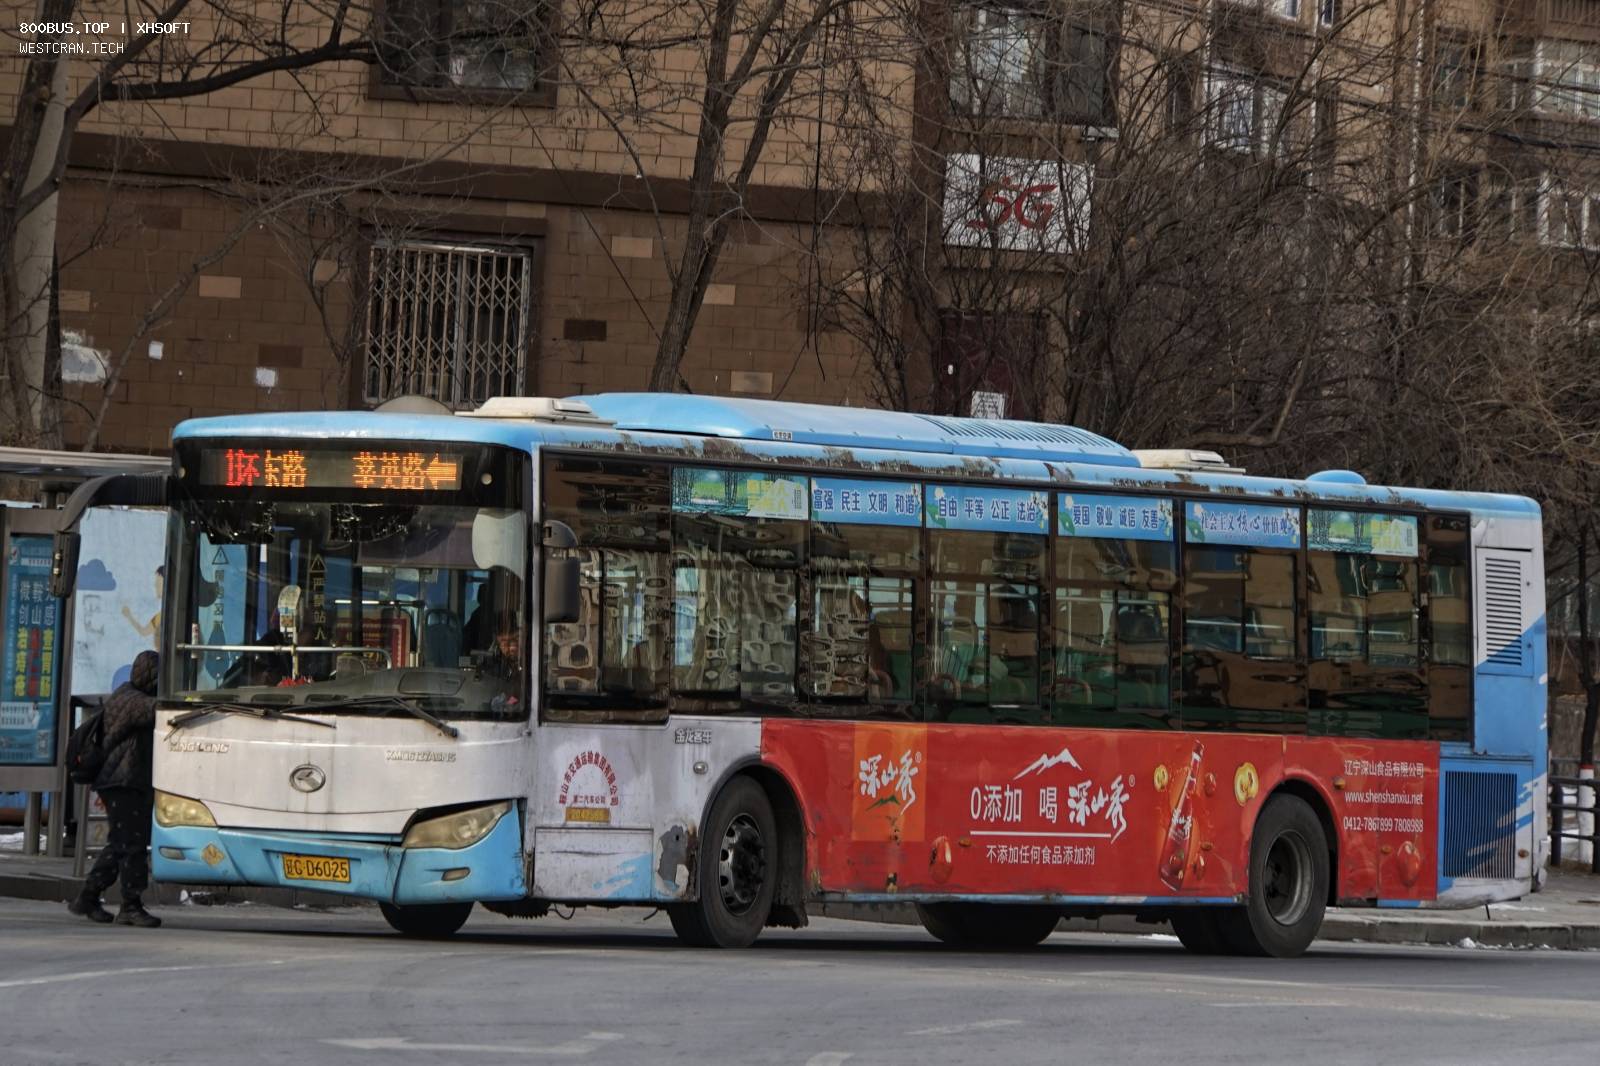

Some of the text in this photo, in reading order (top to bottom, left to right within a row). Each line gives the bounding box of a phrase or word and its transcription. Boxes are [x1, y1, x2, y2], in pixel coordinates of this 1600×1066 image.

[813, 489, 833, 511] 富强
[841, 490, 860, 512] 民主
[868, 491, 888, 513] 文明
[895, 492, 916, 515] 和谐
[938, 497, 1037, 523] 自由 平等 公正 法治
[1073, 505, 1159, 529] 爱国 敬业 诚信 友善
[675, 728, 712, 744] 金龙客车
[1344, 759, 1424, 779] 辽宁深山食品有限公司
[1039, 785, 1058, 823] 喝
[1344, 790, 1424, 806] www.shenshanxiu.net
[986, 845, 1095, 865] 不添加任何食品添加剂
